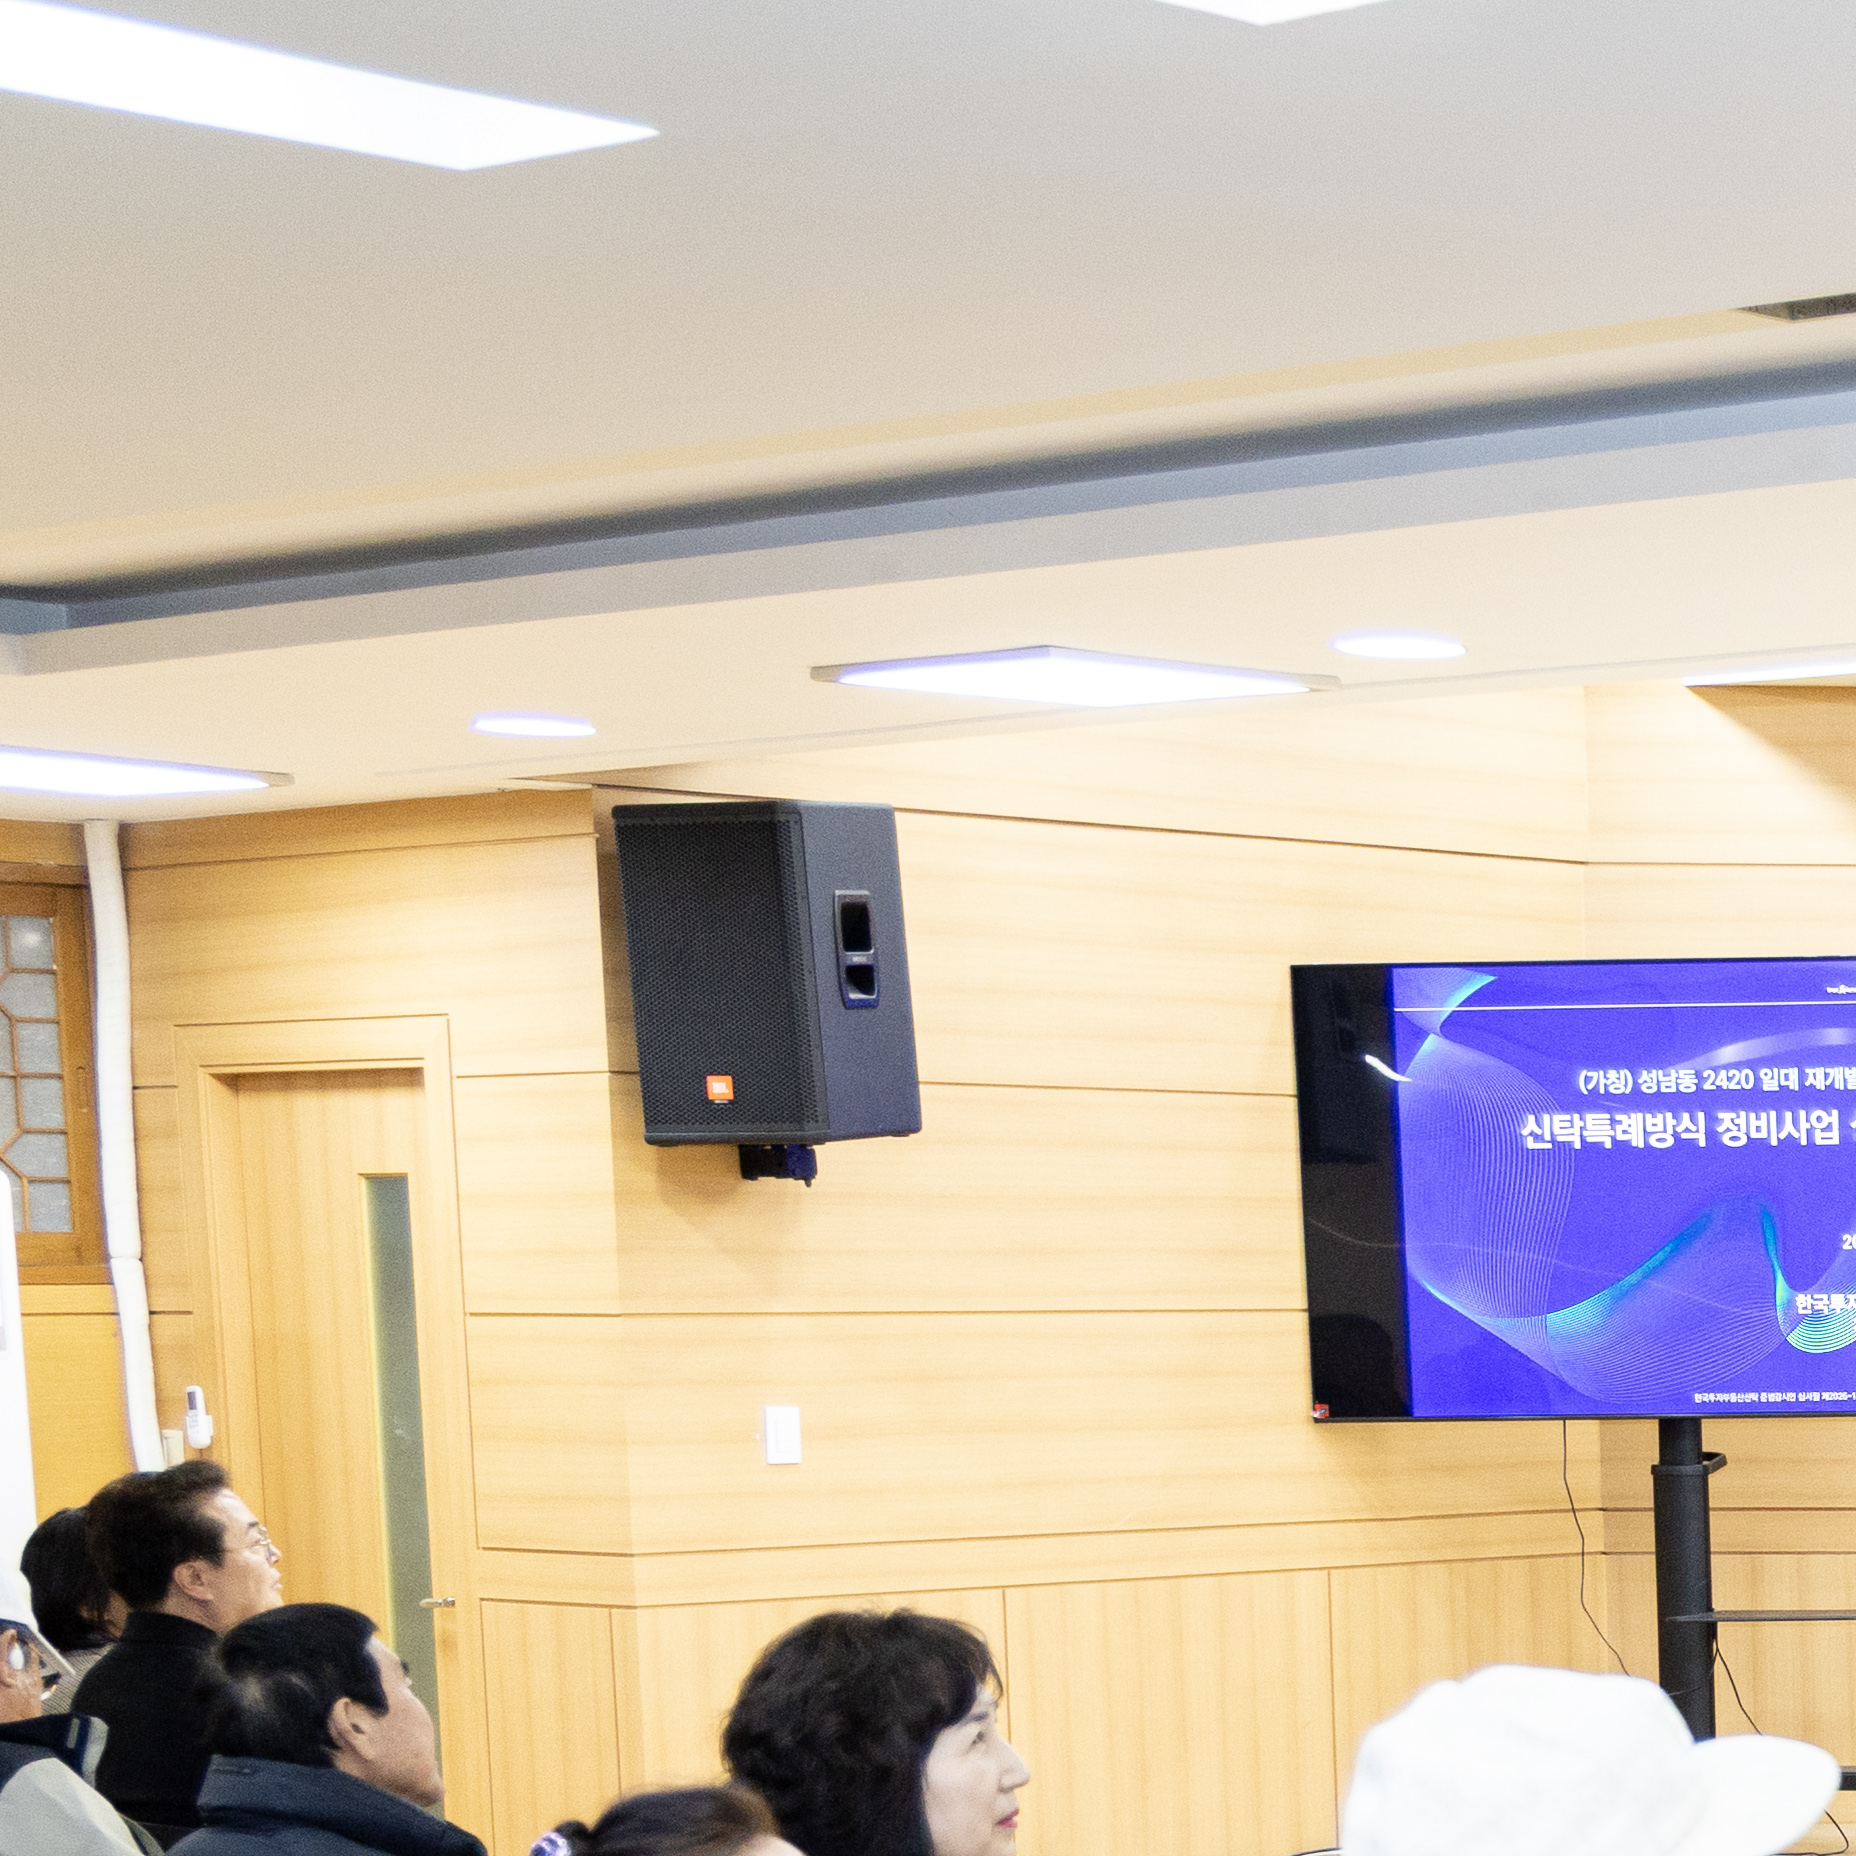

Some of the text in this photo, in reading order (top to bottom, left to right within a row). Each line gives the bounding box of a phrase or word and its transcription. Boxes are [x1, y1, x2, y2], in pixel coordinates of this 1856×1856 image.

[1578, 1068, 1634, 1094] (가칭)
[1638, 1068, 1699, 1094] 성남동
[1702, 1068, 1755, 1091] 2420
[1759, 1067, 1800, 1091] 일대
[1520, 1111, 1707, 1149] 신탁특례방식
[1716, 1108, 1840, 1148] 정비사업
